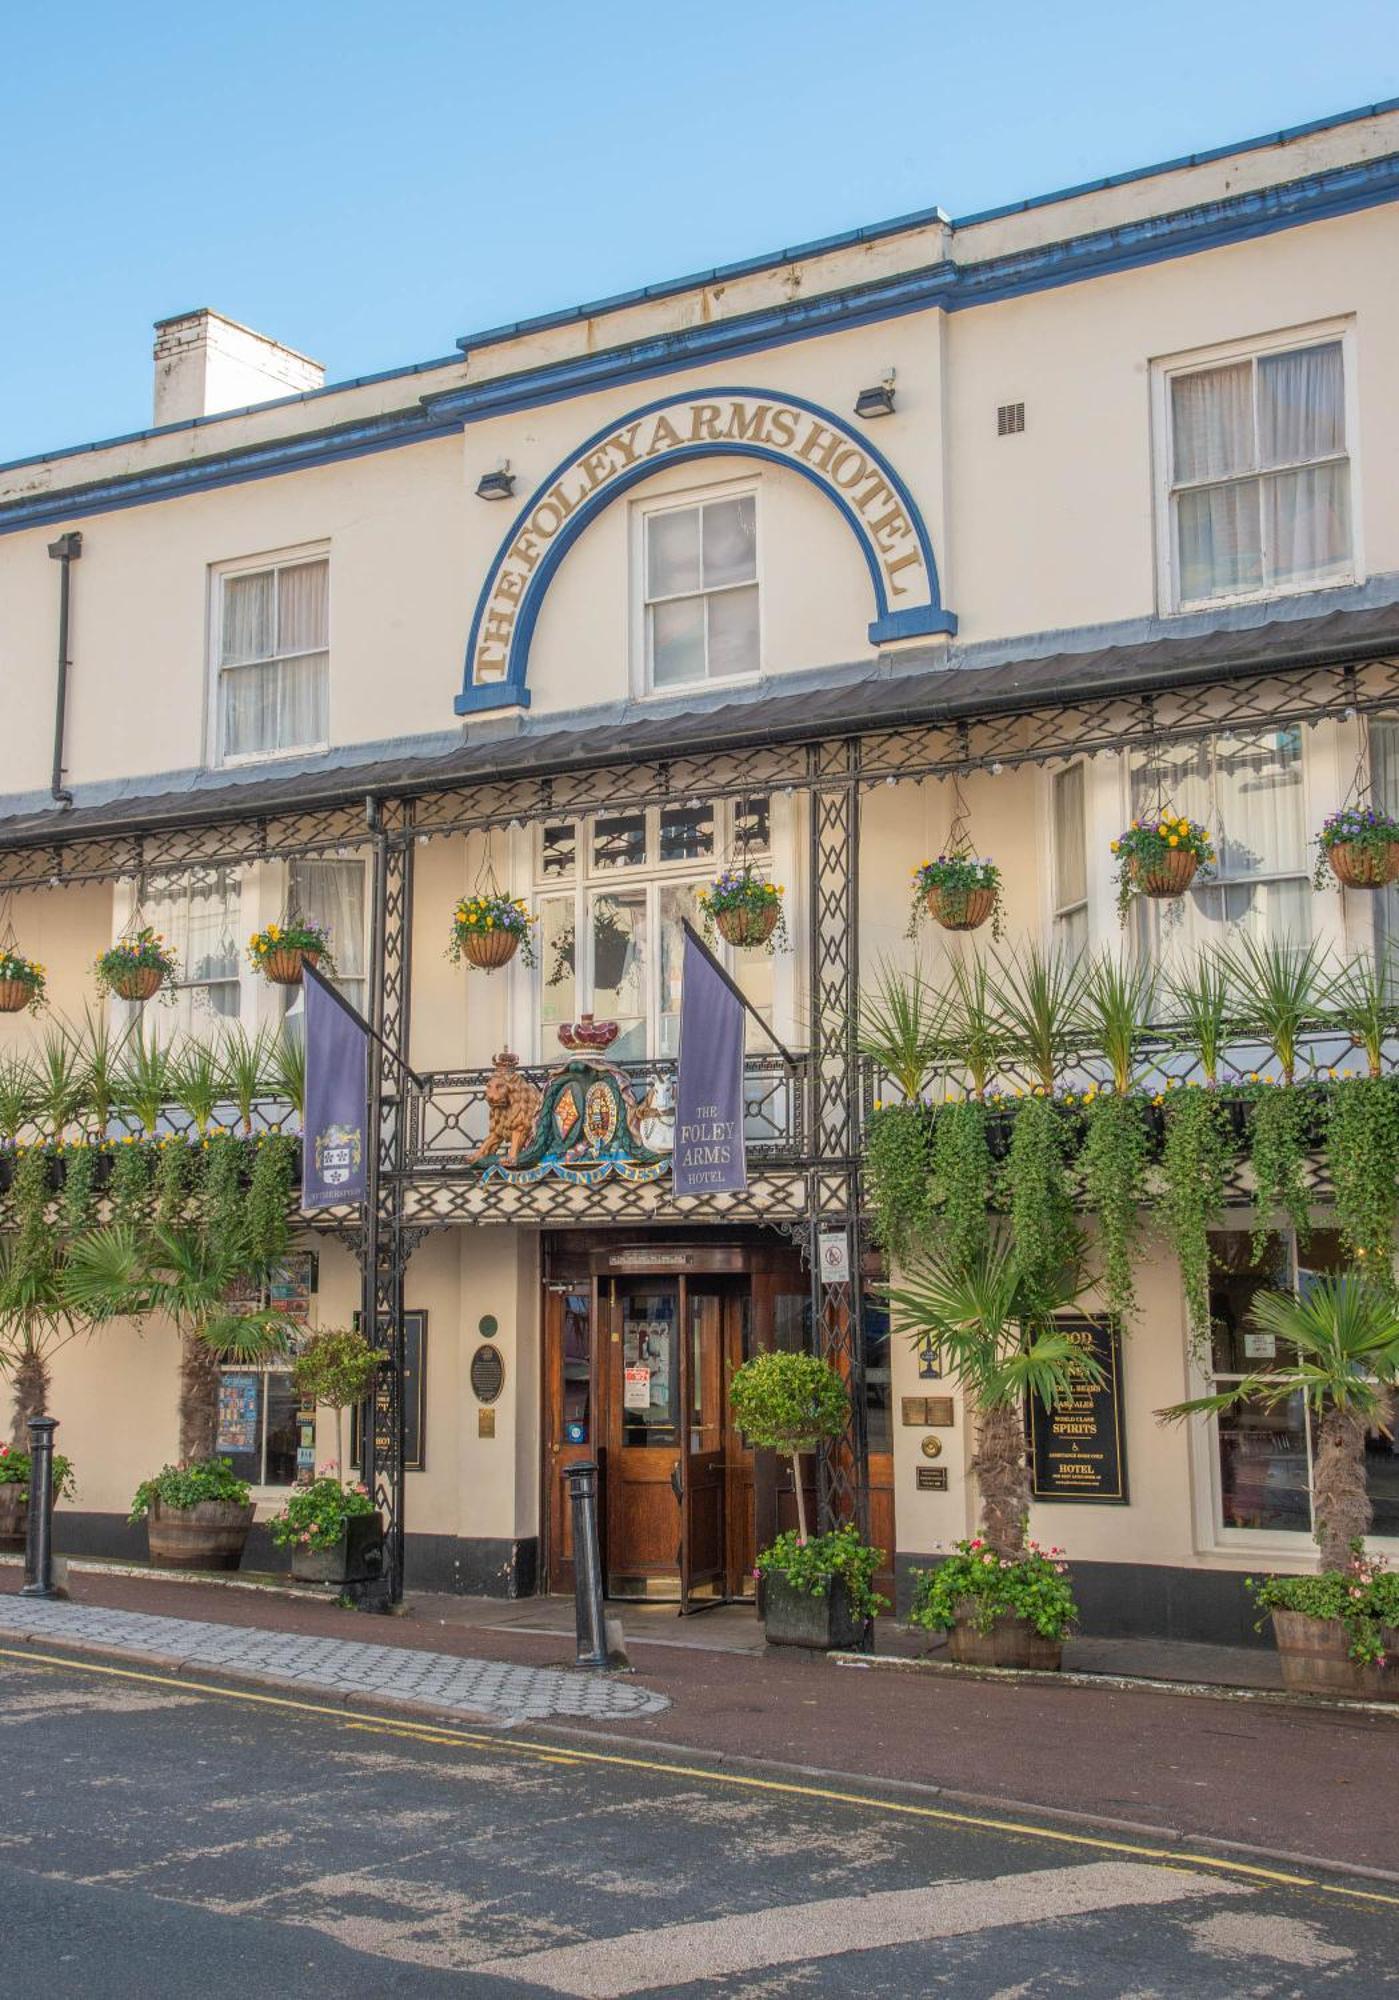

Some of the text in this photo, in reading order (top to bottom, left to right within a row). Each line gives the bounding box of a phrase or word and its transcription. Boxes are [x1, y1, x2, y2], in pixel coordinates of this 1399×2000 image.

[476, 401, 924, 684] THE FOLEY ARMS HOTEL
[696, 1106, 717, 1118] THE
[681, 1122, 735, 1143] FOLEY
[683, 1146, 730, 1166] ARMS
[688, 1171, 725, 1184] HOTEL
[1053, 1423, 1097, 1434] SPIRITS
[1059, 1464, 1095, 1474] HOTEL
